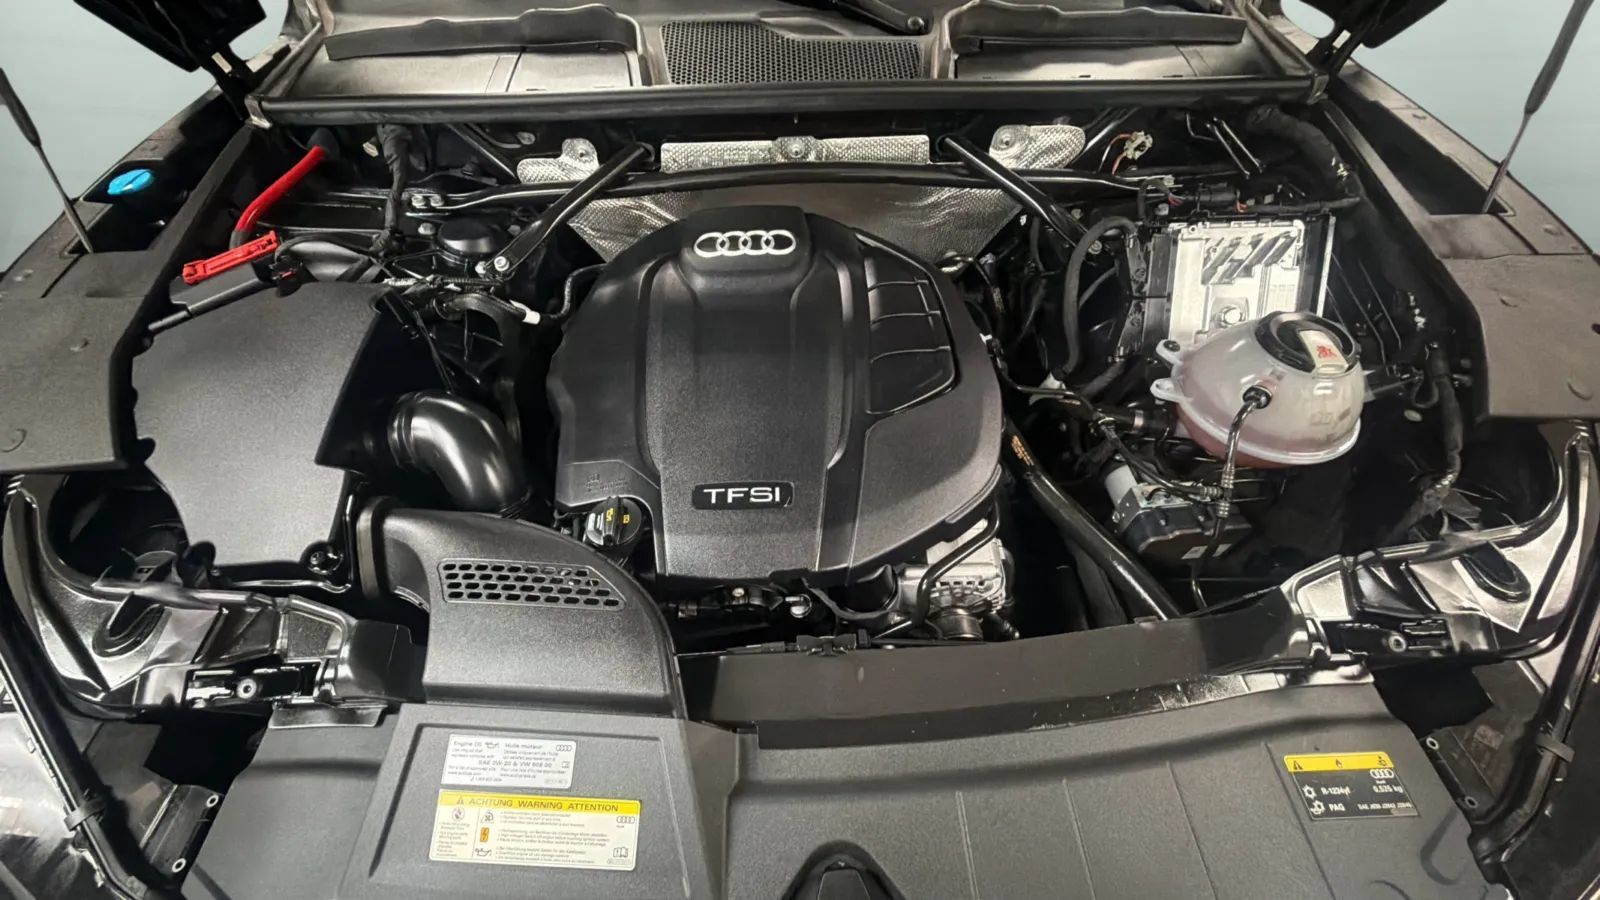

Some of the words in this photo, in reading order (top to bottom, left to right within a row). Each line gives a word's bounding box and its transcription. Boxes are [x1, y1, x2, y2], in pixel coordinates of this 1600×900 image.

[703, 487, 780, 504] TFSI
[469, 797, 513, 807] ACHTUNG
[518, 799, 563, 810] WARNING
[567, 801, 619, 812] ATTENTION
[1328, 803, 1346, 812] PAG
